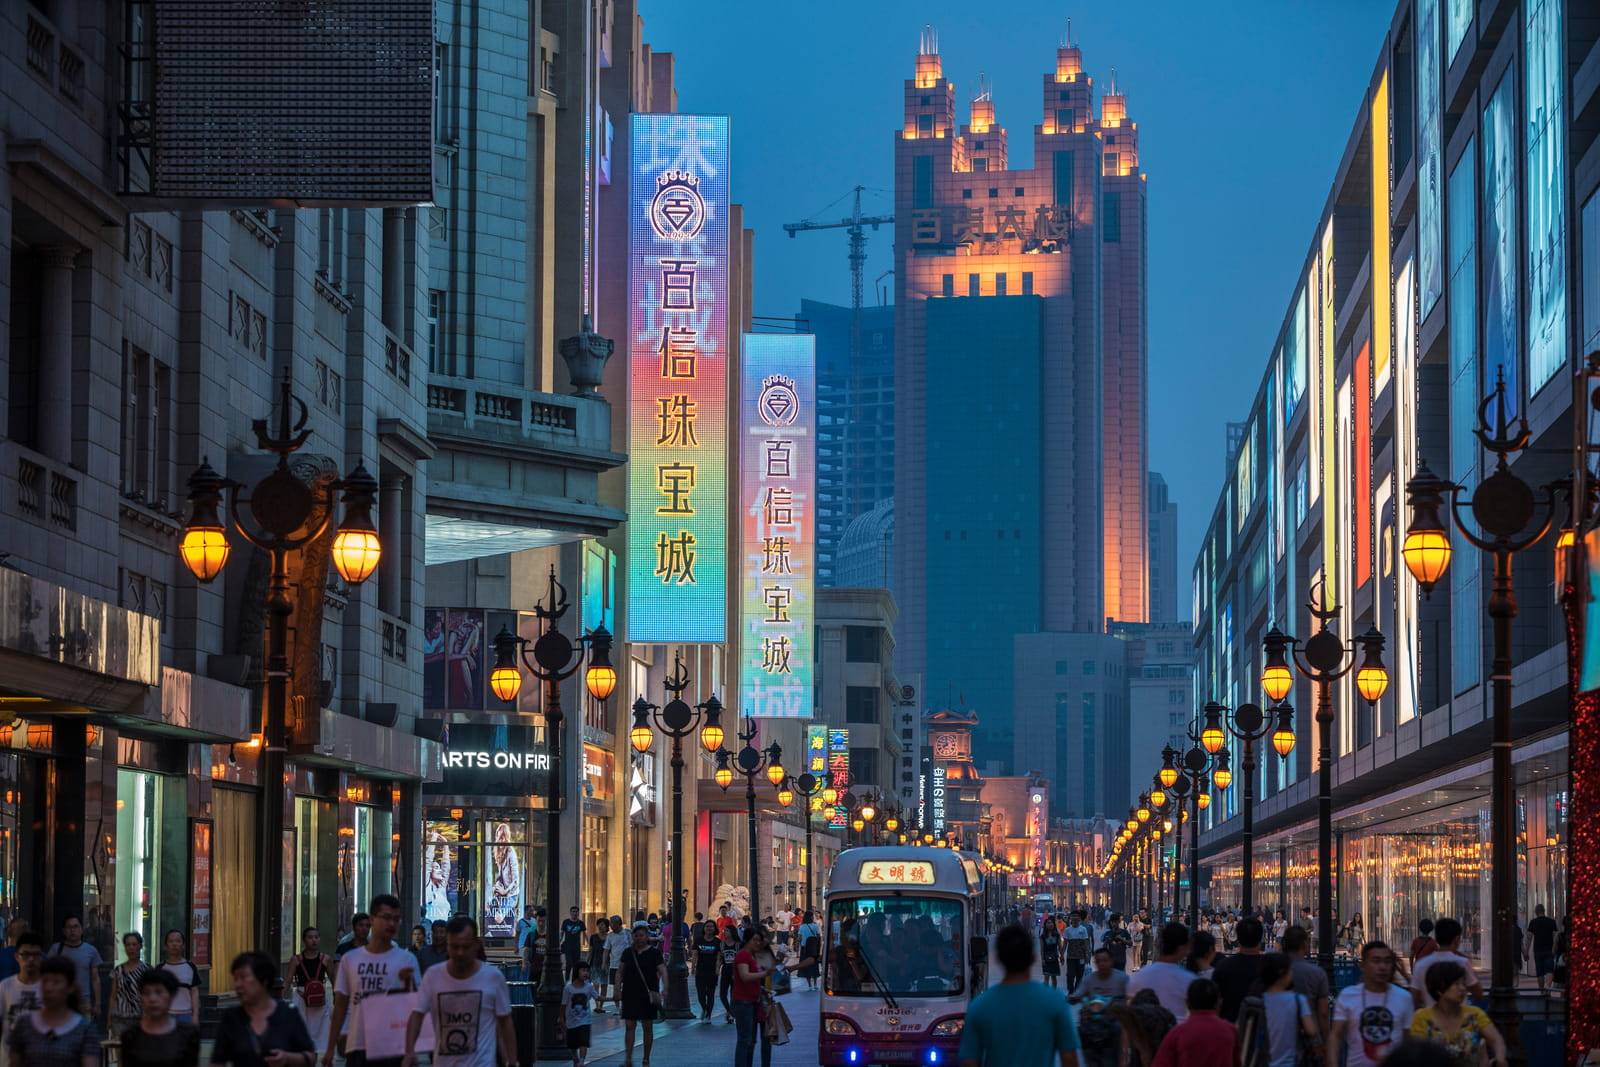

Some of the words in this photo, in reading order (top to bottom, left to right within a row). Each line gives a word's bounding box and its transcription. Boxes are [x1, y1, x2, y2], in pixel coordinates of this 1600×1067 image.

[655, 258, 699, 586] 百信珠宝城
[761, 440, 793, 673] 百信珠宝城
[494, 752, 521, 769] ON
[525, 753, 549, 770] FIR
[868, 864, 927, 882] 文明號
[358, 962, 388, 975] CALL
[360, 976, 384, 990] THE
